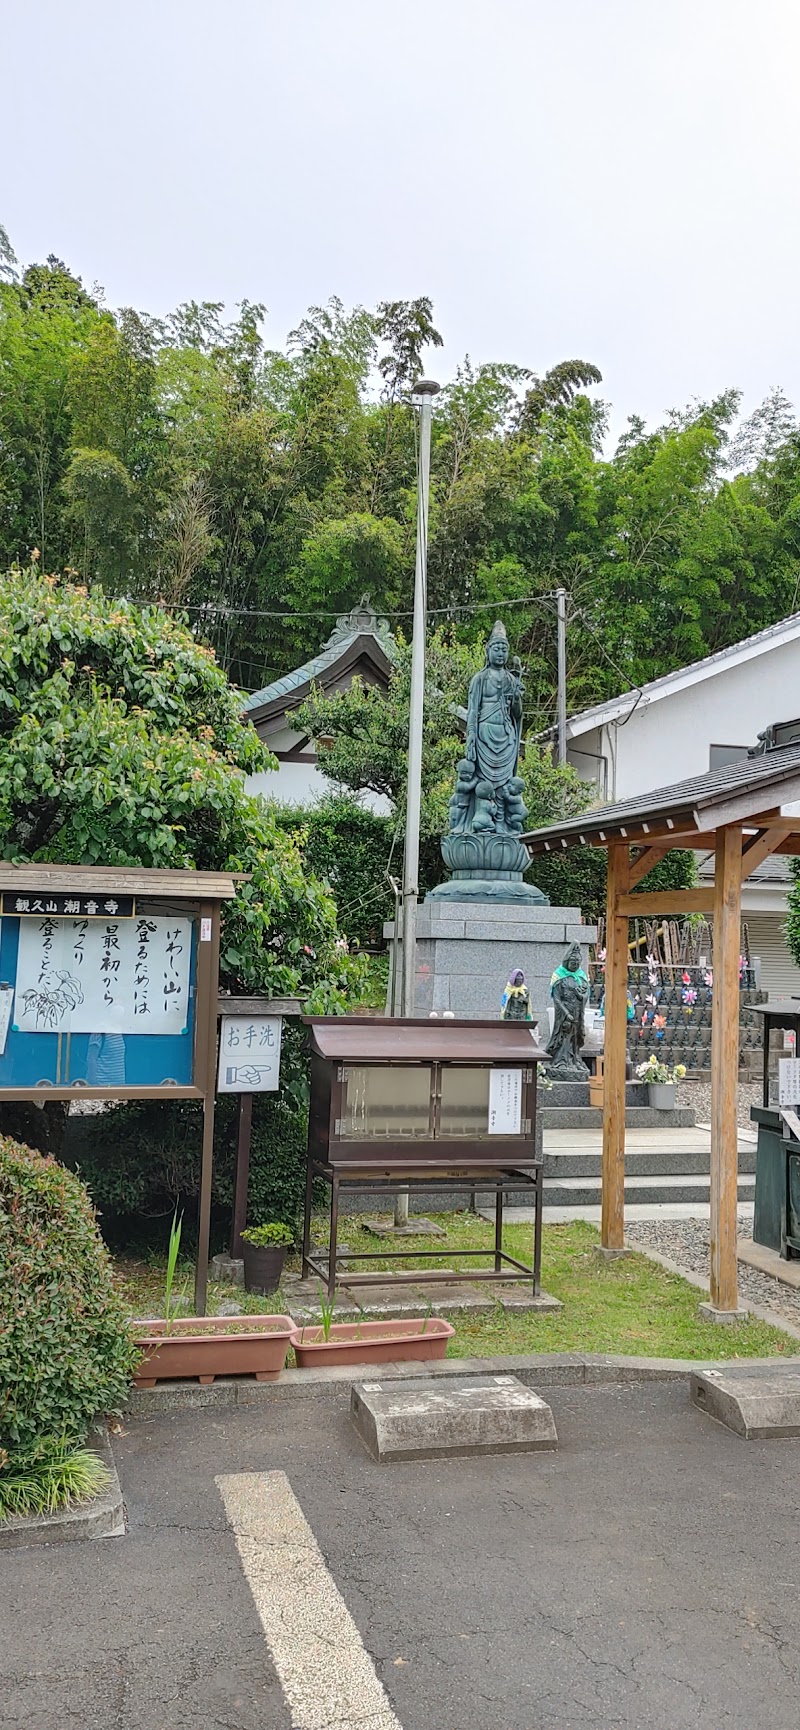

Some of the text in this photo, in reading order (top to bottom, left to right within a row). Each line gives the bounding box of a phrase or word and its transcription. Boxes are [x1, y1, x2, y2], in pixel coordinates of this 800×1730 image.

[15, 897, 119, 915] 観久山 潮音寺
[37, 917, 59, 986] 登ることだ
[72, 918, 90, 966] ゆっくり
[100, 924, 121, 1007] 最初から
[133, 919, 157, 1015] 登るためには
[164, 928, 183, 1012] けわしい山に
[227, 1024, 275, 1049] お手洗
